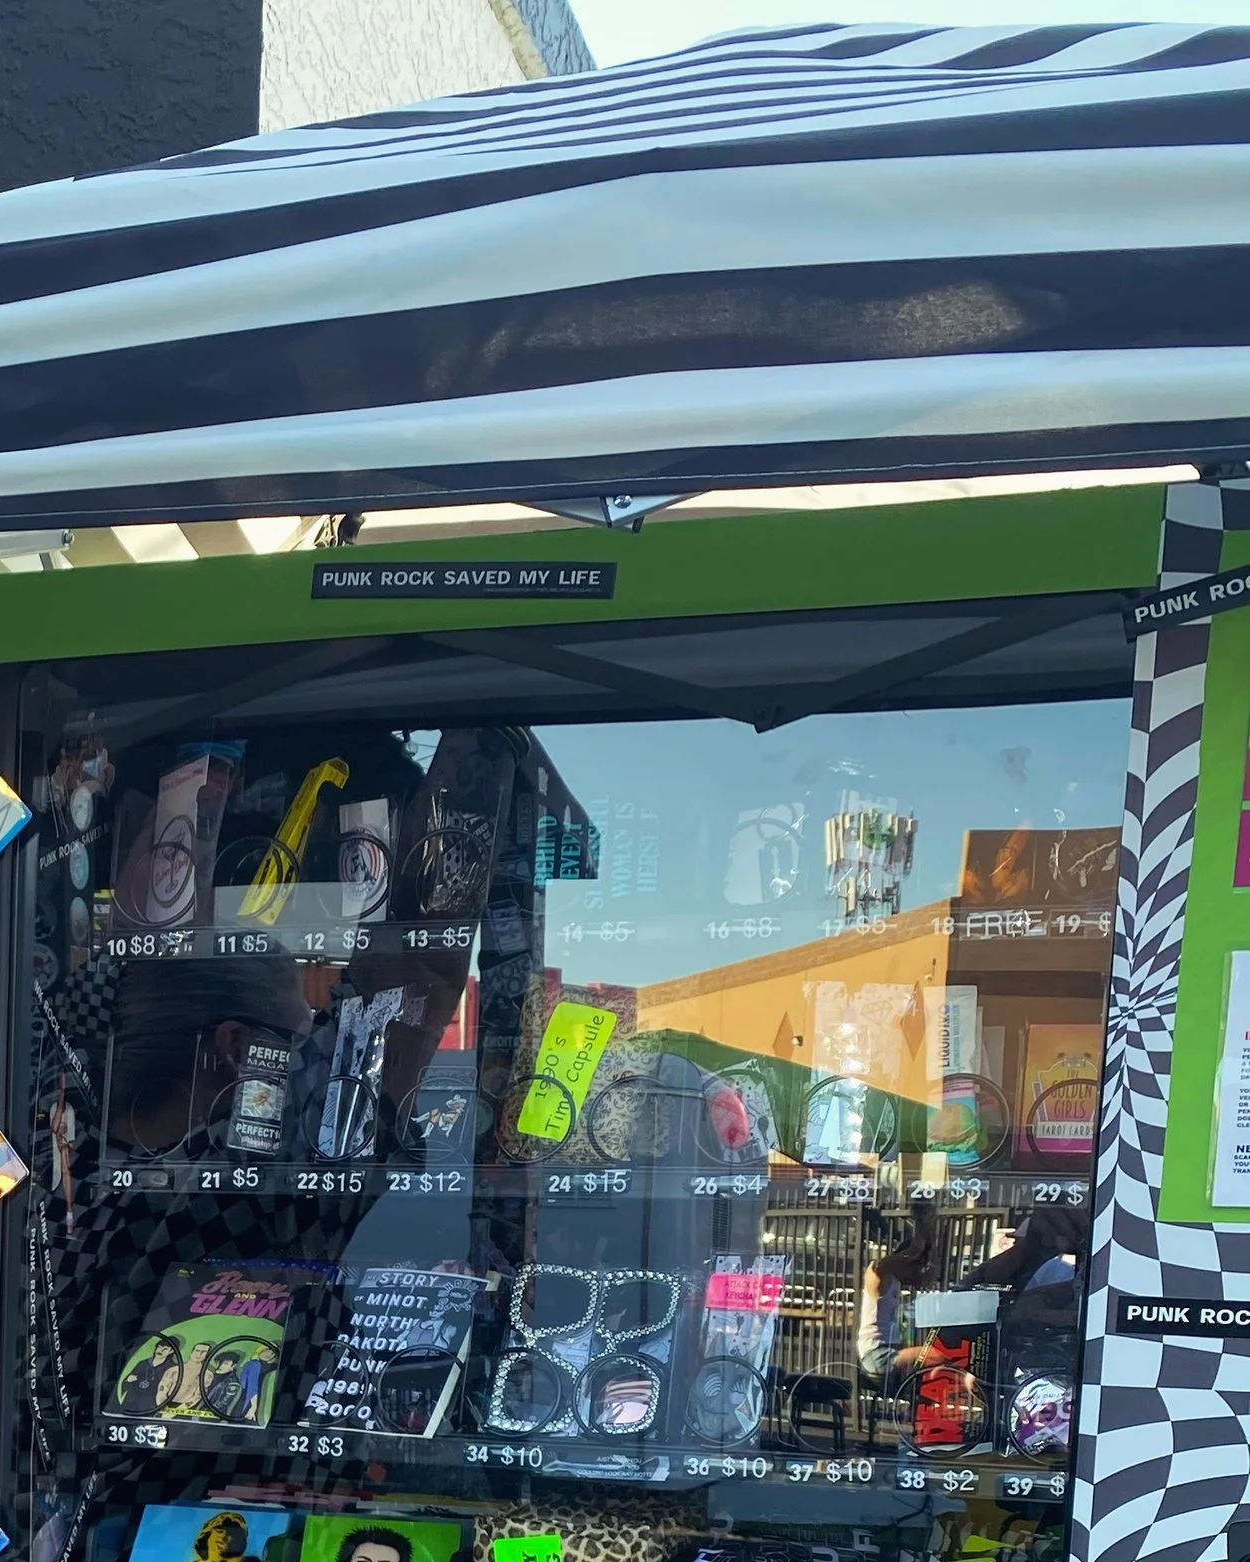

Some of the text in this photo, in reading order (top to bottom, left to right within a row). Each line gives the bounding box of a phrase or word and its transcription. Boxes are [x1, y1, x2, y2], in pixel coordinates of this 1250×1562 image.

[322, 570, 601, 586] PUNK ROCK SAVED MY LIFE
[1135, 591, 1199, 624] PUNK
[107, 939, 126, 955] 10
[218, 936, 236, 952] 11
[243, 934, 268, 952] $5
[305, 933, 324, 949] 12
[343, 929, 370, 949] $5
[407, 930, 428, 947] 13
[443, 927, 470, 947] $5
[561, 924, 583, 942] 14
[601, 921, 629, 941] $5
[709, 921, 731, 939] 16
[932, 917, 954, 935] 18
[1056, 915, 1082, 933] 19
[44, 1000, 81, 1072] ROCK SAVED
[566, 1014, 605, 1083] Capsule
[535, 1036, 566, 1100] 1990's
[1051, 1080, 1092, 1099] GOLDEN
[1054, 1100, 1086, 1118] GIRLS
[1041, 1123, 1067, 1136] TAROT
[113, 1168, 1061, 1202] 20 21 $5 22 $15 23 $12 24 $15 26 $4 27 $8 28 $3 29
[379, 1273, 439, 1287] STORY
[190, 1293, 288, 1319] GLENN
[1127, 1305, 1190, 1323] PUNK
[44, 1248, 54, 1291] ROCK
[50, 1300, 60, 1351] SAVED
[56, 1356, 64, 1380] MY
[60, 1385, 70, 1418] LIFE
[350, 1313, 414, 1331] NORTH
[338, 1334, 408, 1352] DAKOTA
[337, 1357, 387, 1373] PUNK
[32, 1396, 41, 1420] MY
[108, 1426, 1033, 1495] 30 32 $3 34 $10 36 $10 37 $10 38 $2 39
[77, 1501, 86, 1523] MY
